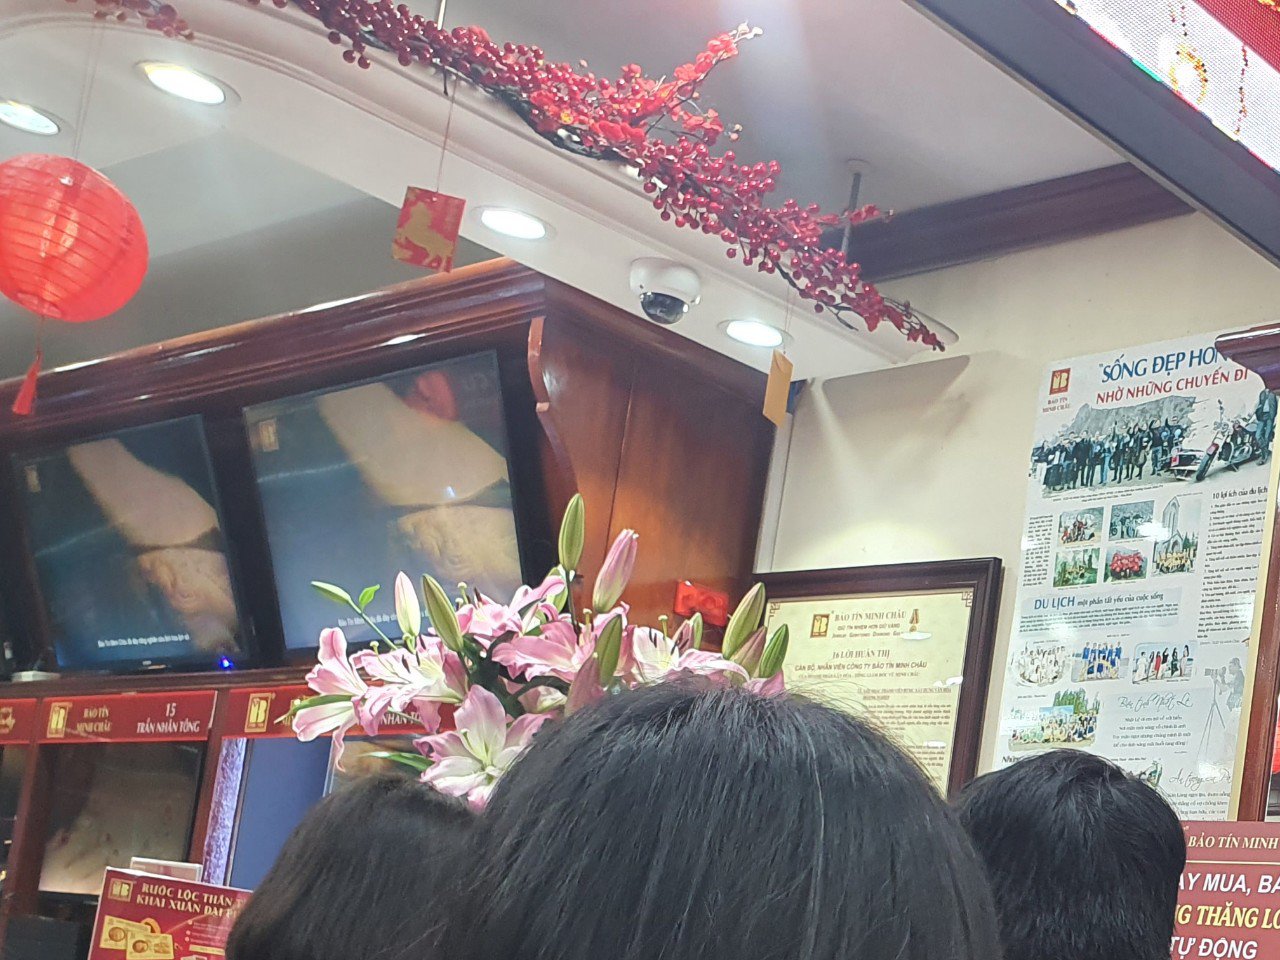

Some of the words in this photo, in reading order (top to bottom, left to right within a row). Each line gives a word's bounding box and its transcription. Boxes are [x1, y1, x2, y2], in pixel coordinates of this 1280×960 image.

[1152, 352, 1186, 374] ĐẸP
[1096, 389, 1123, 404] NHỜ
[1126, 380, 1178, 398] NHỮNG
[1176, 370, 1230, 391] CHUYẾN
[1034, 599, 1049, 609] DU
[1052, 596, 1075, 610] LỊCH
[166, 703, 177, 717] 15
[1188, 832, 1215, 848] BẢO
[1218, 833, 1239, 849] TÍN
[1242, 837, 1278, 849] MINH
[1203, 874, 1252, 896] MUA,
[136, 894, 165, 908] KHAI
[178, 889, 200, 901] LỘC
[1196, 901, 1259, 928] THĂNG
